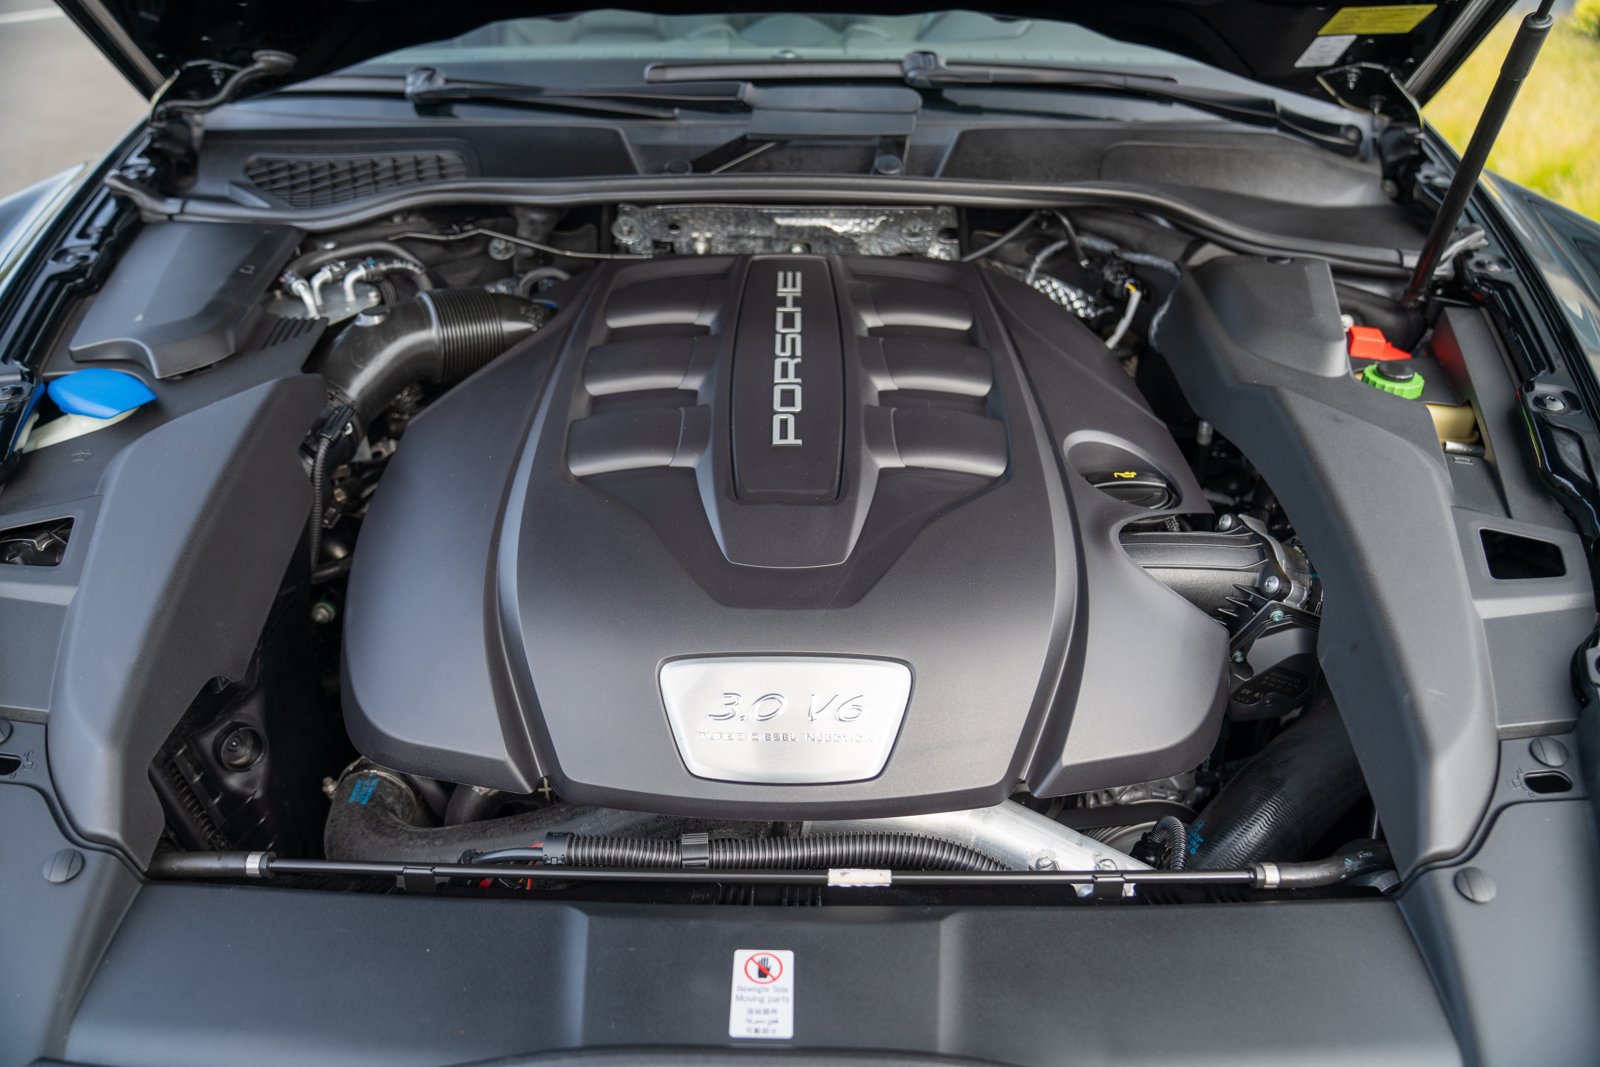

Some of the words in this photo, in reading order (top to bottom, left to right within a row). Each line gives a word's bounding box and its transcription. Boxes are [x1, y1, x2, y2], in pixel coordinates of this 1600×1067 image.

[772, 271, 802, 446] PORSCHE
[708, 693, 784, 721] 3.0
[807, 693, 864, 722] V6
[752, 732, 797, 742] DIESEL
[804, 731, 875, 743] INJECTION
[735, 994, 765, 1004] Moving
[768, 996, 790, 1004] parts
